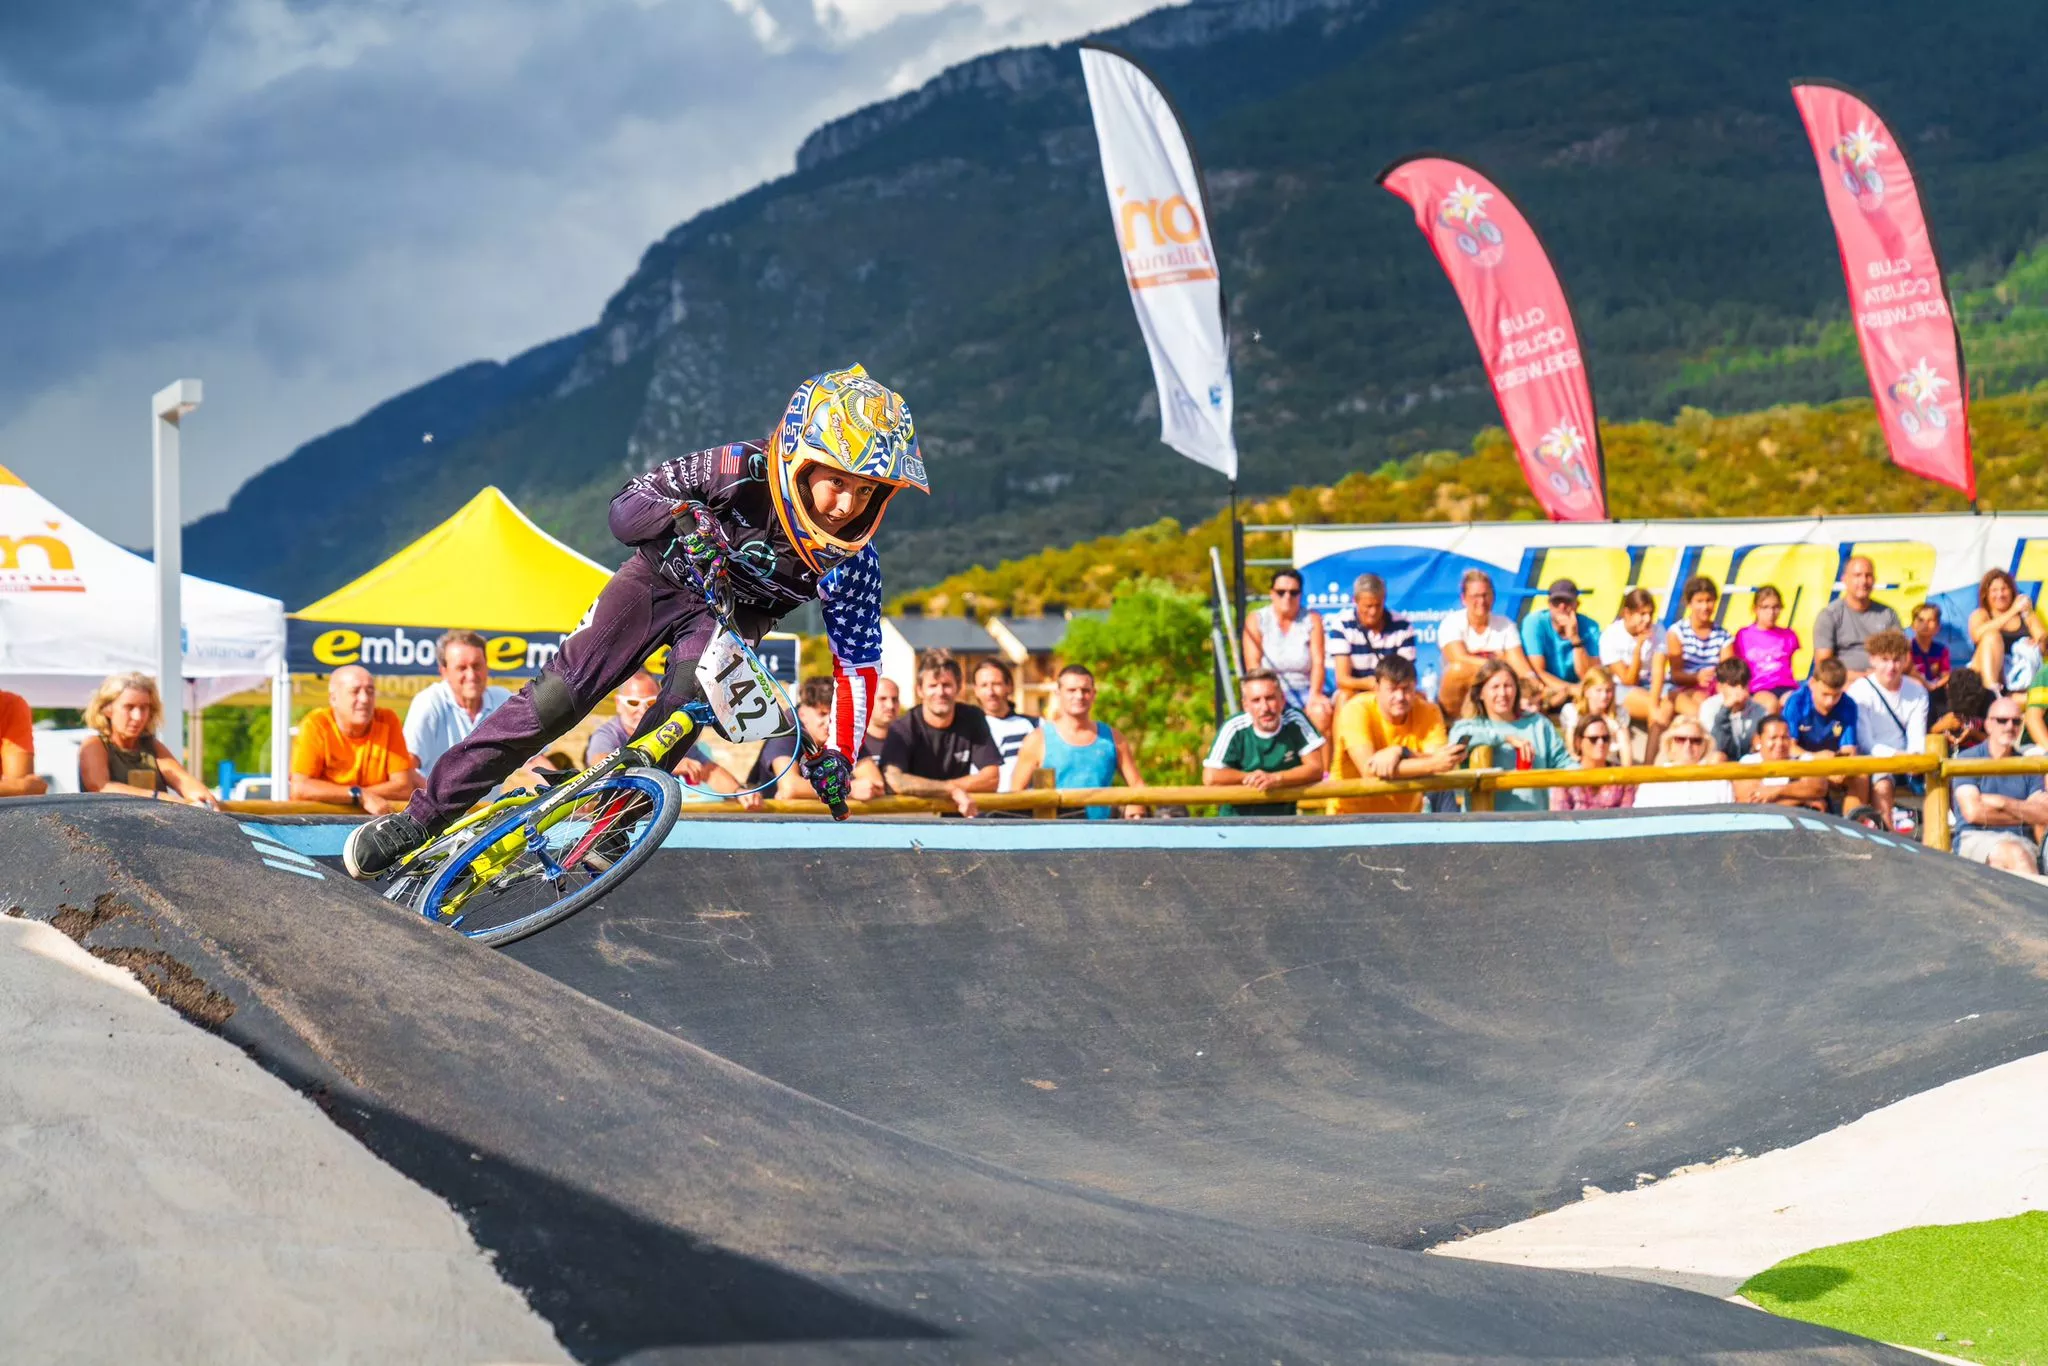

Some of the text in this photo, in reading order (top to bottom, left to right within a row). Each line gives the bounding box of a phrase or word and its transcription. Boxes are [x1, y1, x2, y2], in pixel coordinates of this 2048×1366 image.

[690, 452, 700, 487] IMANO
[312, 628, 437, 666] embo
[715, 653, 767, 732] 142
[568, 747, 621, 792] ANSWER
